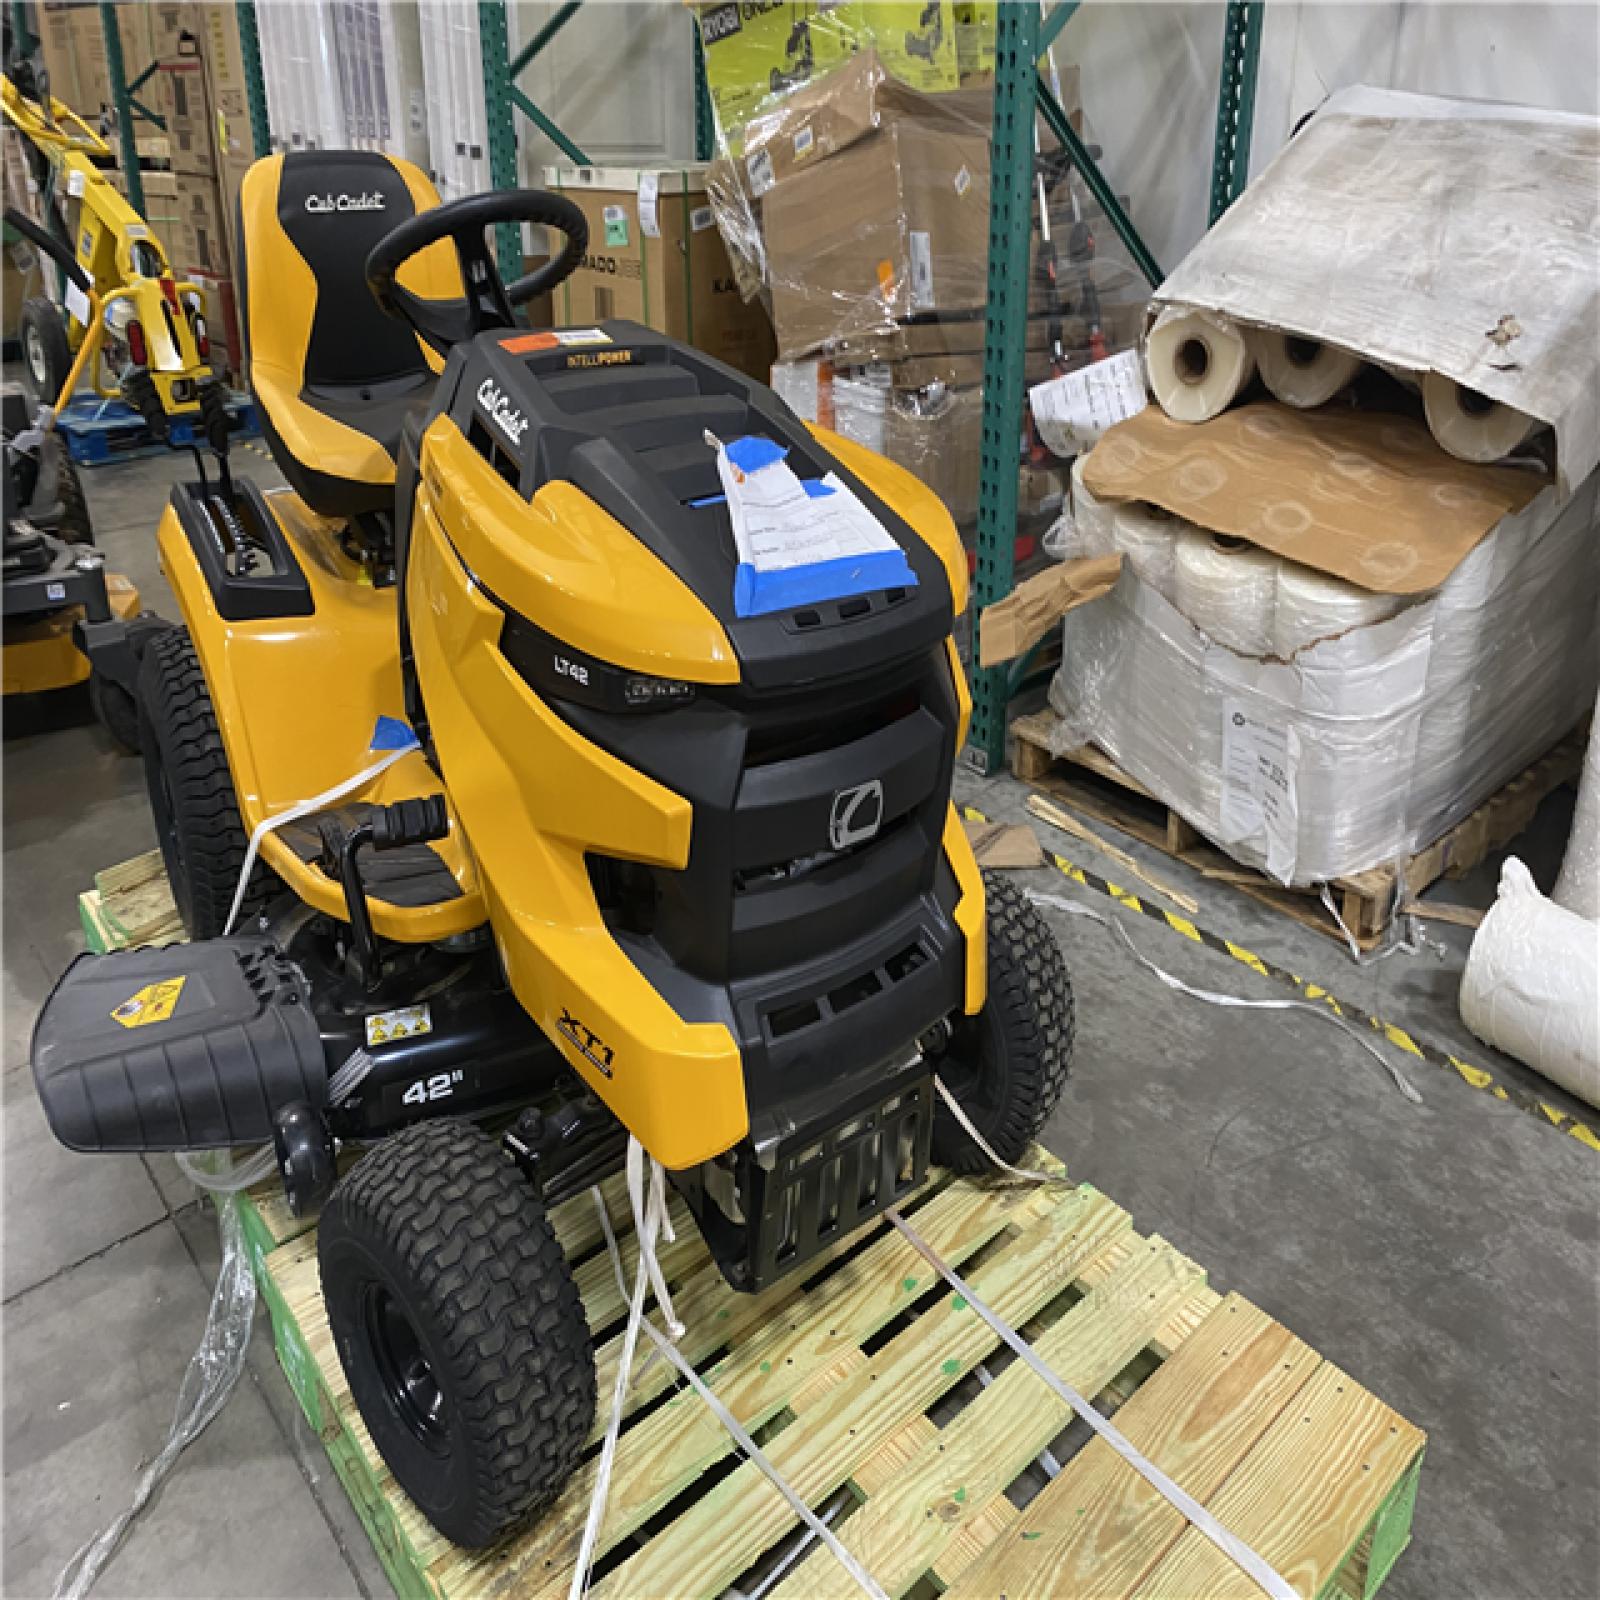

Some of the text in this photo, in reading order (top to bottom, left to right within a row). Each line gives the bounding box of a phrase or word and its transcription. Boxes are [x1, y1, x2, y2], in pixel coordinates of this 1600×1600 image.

[703, 5, 738, 40] RYOBI
[304, 191, 386, 213] Cub Cadet
[477, 378, 528, 446] Cub Cadet
[554, 655, 589, 686] LT42
[559, 1007, 615, 1067] XT1
